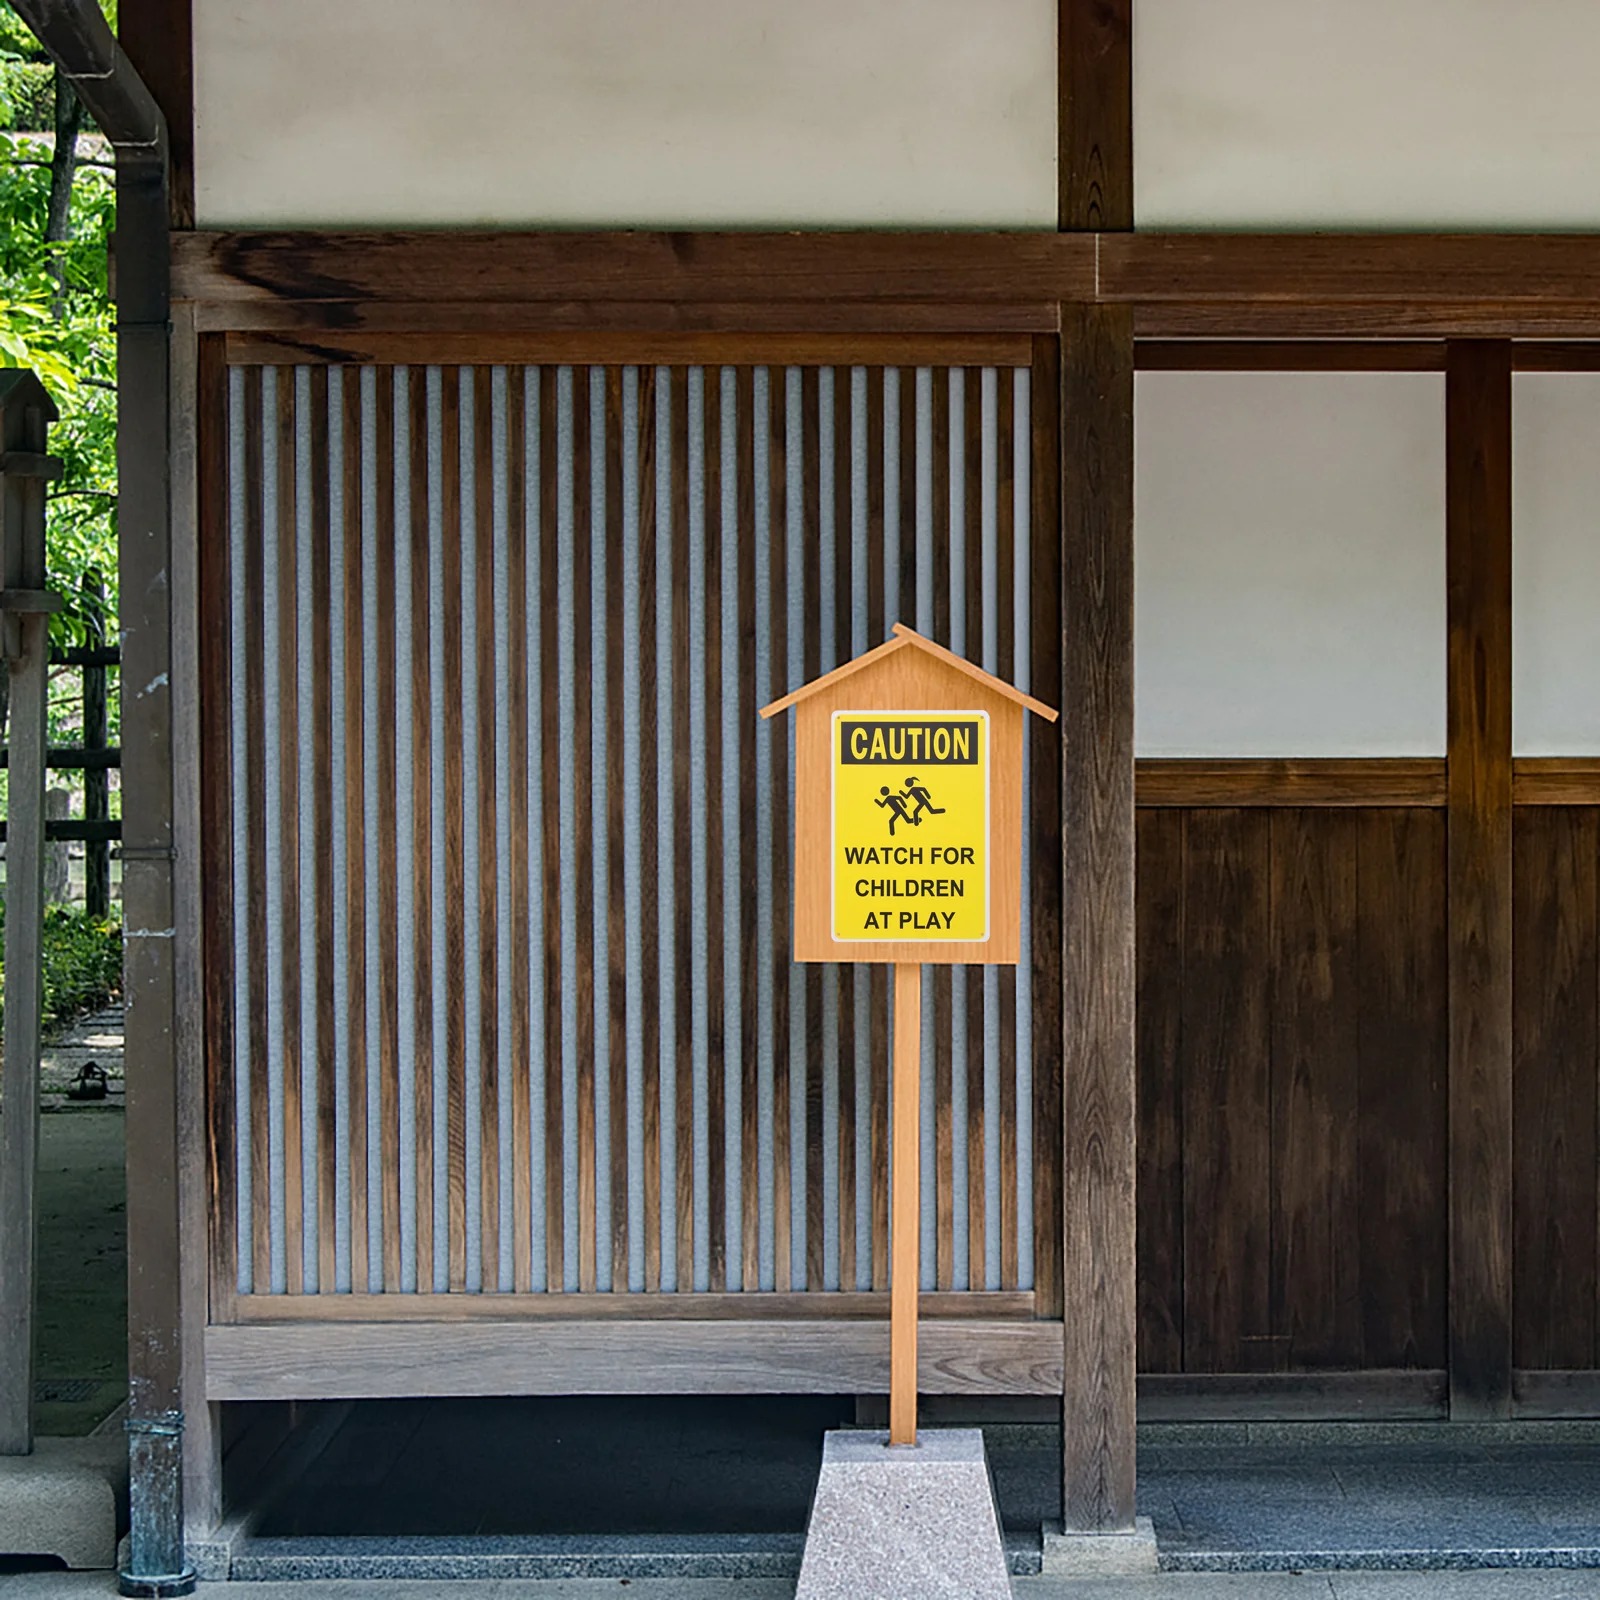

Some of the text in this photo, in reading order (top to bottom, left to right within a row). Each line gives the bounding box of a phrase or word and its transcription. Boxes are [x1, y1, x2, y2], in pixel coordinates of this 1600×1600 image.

[851, 728, 969, 759] CAUTION
[845, 847, 975, 864] WATCH FOR
[856, 879, 963, 896] CHILDREN
[864, 912, 955, 929] AT PLAY
